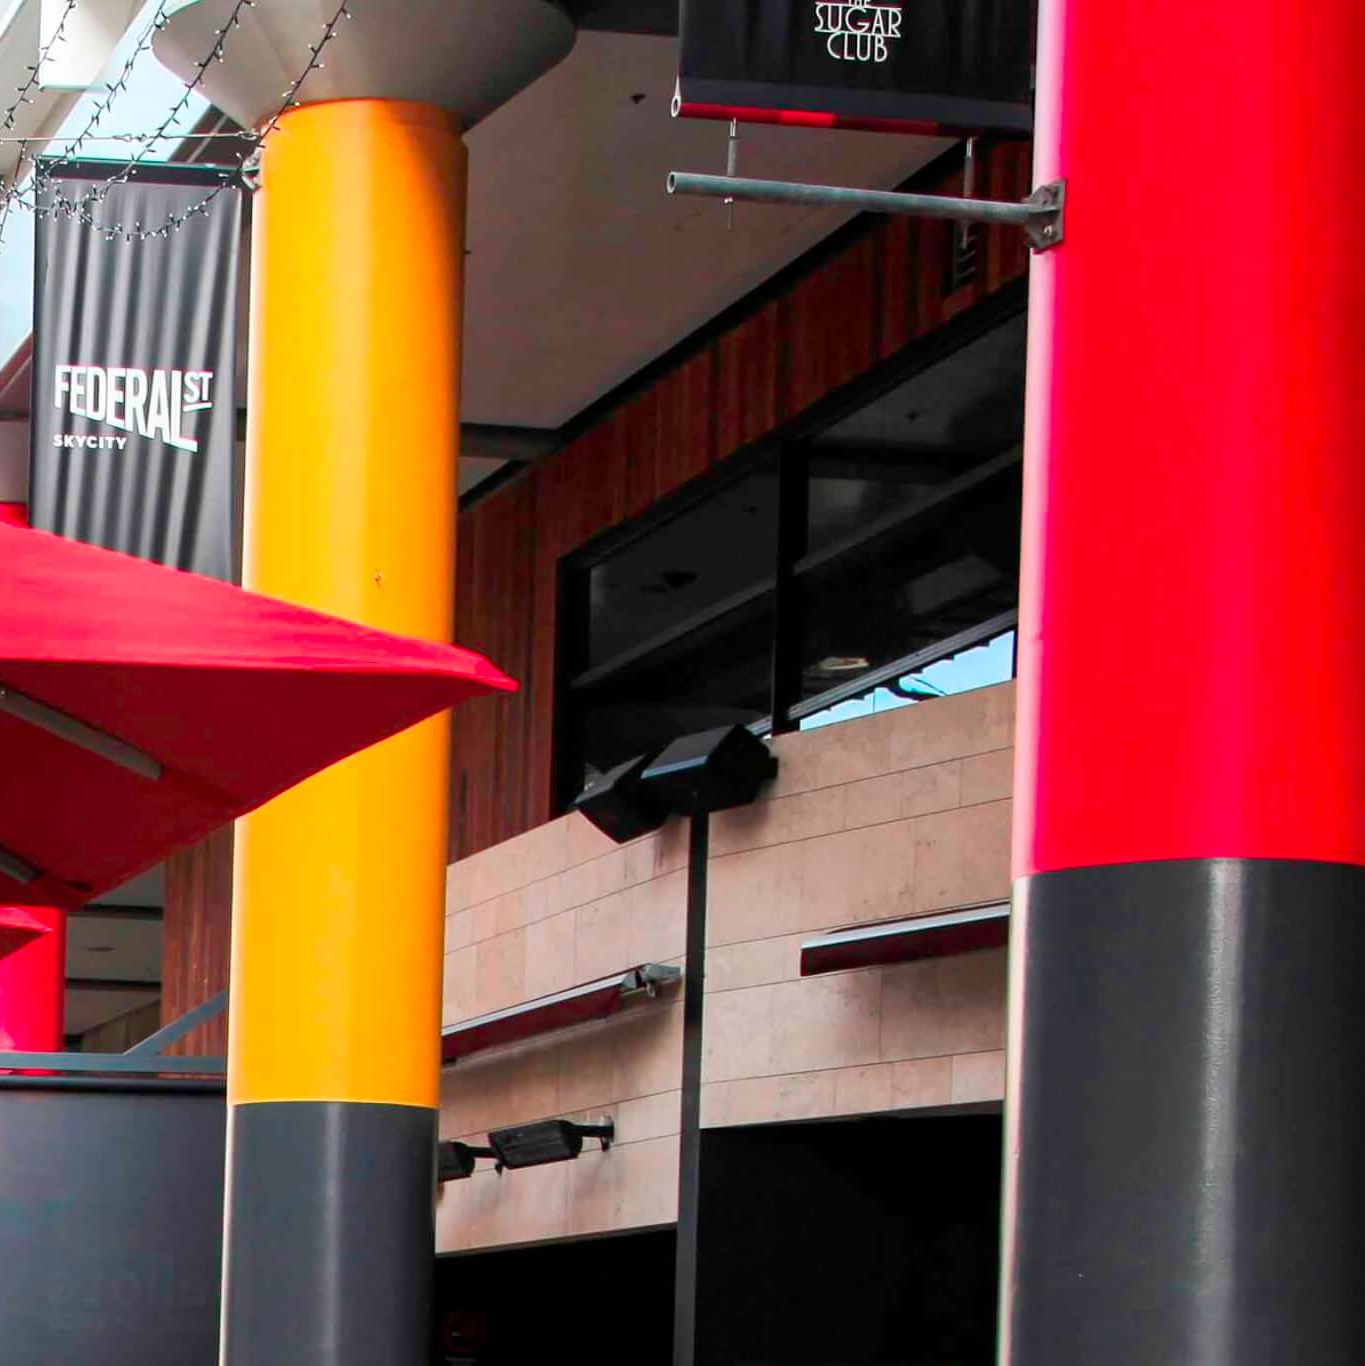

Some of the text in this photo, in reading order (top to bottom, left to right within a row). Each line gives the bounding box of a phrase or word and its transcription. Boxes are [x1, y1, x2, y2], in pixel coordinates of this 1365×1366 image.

[814, 3, 902, 38] SUGAR
[827, 31, 888, 62] CLUB
[54, 365, 214, 453] FEDERAL ST
[53, 434, 128, 450] SKYCITY
